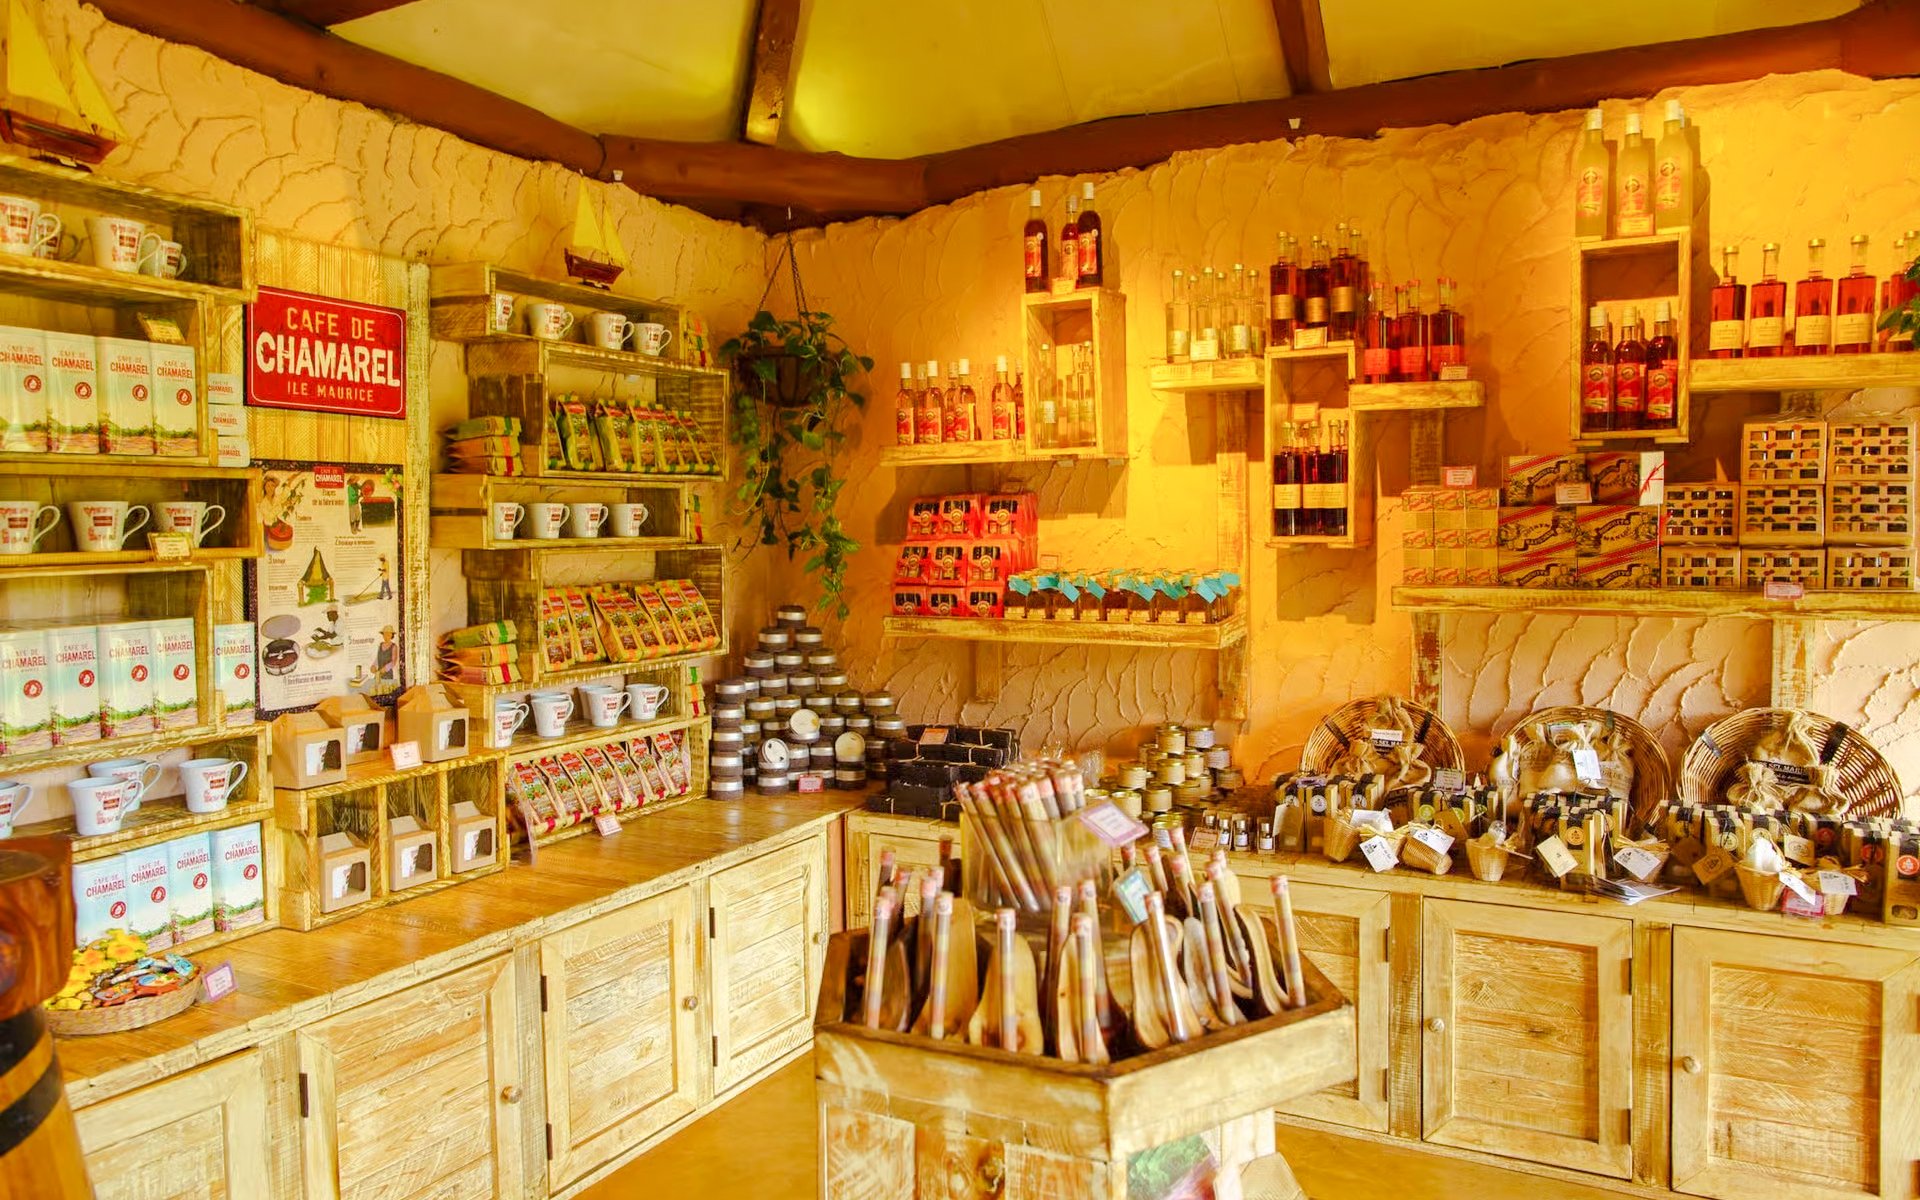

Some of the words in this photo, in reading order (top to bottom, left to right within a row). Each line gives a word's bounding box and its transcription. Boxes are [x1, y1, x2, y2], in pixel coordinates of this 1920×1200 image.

[287, 307, 339, 336] CAFE
[351, 317, 375, 341] DE
[52, 357, 94, 371] CHAMAREL
[255, 331, 400, 387] CHAMAREL
[110, 362, 150, 375] CHAMAREL
[157, 367, 194, 379] CHAMAREL
[287, 381, 308, 395] ILE
[317, 384, 373, 402] MAURICE
[316, 474, 343, 483] CHAMAREL
[109, 646, 149, 658] CHAMAREL
[157, 641, 193, 653] CHAMAREL
[215, 645, 252, 656] CHAMAREL
[2, 656, 47, 670] CHAMAREL
[56, 651, 96, 664] CHAMAREL
[225, 845, 259, 861] CHAMAREL
[177, 853, 211, 869] CHAMAREL
[131, 866, 167, 882] CHAMAREL
[86, 879, 126, 897] CHAMAREL
